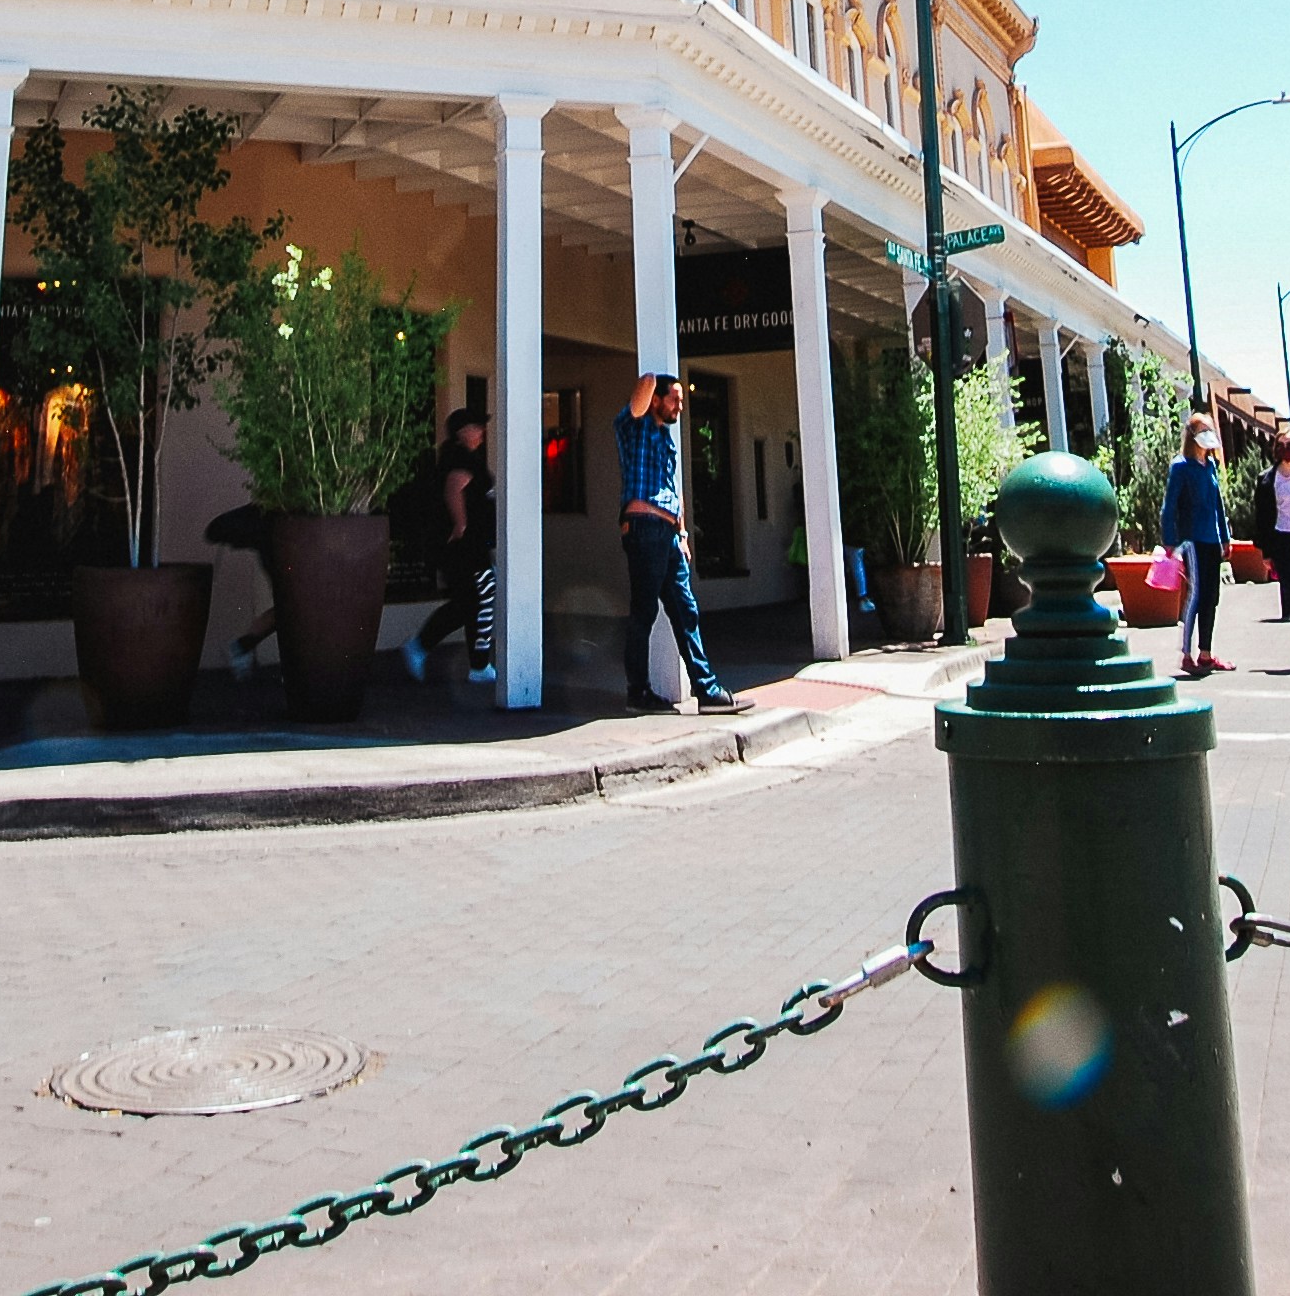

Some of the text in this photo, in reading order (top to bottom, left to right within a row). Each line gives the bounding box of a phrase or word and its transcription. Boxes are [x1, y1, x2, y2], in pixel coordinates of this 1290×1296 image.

[945, 227, 989, 249] PALACE
[678, 318, 711, 335] ANTA
[714, 315, 729, 332] FE
[733, 312, 759, 330] DRY
